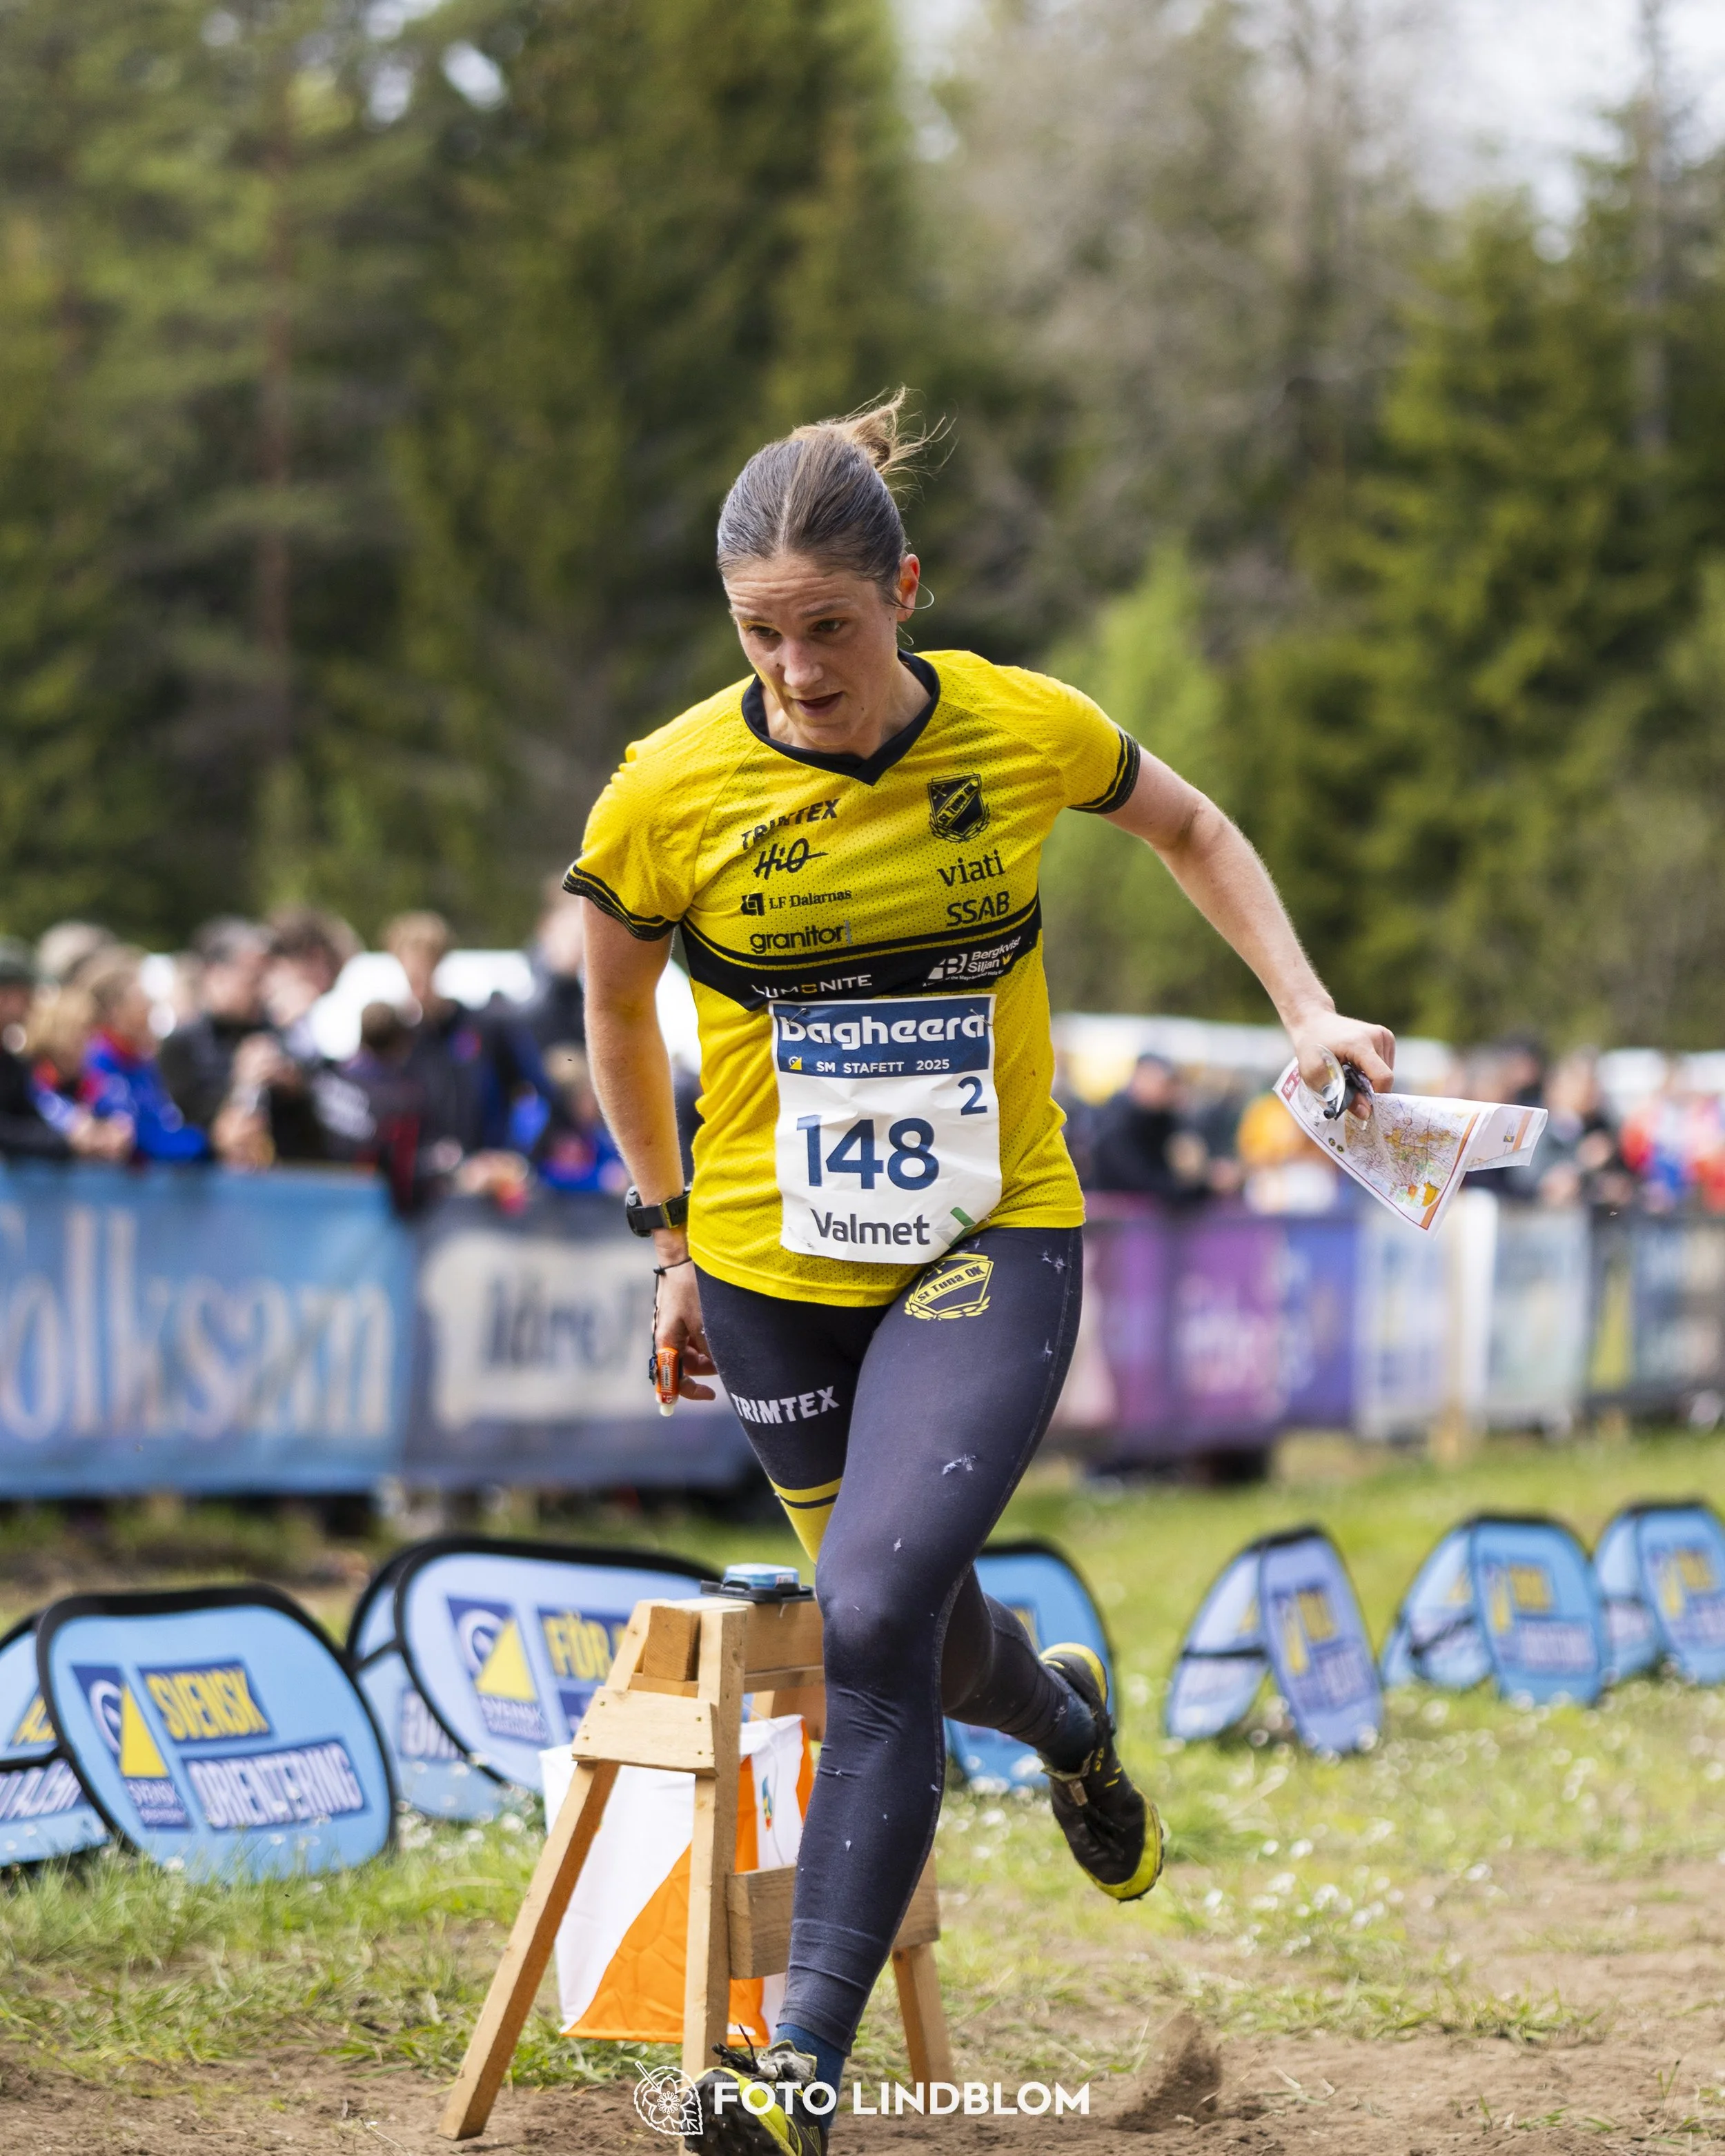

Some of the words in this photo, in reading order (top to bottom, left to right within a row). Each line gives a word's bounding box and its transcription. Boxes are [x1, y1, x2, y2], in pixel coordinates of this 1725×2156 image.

[936, 849, 1005, 887] viati
[769, 896, 787, 910] LF
[789, 889, 852, 909] Dalarnas
[946, 891, 1010, 927] SSAB
[749, 924, 844, 954] granitor
[972, 936, 1021, 961] Bergkvist
[967, 959, 1000, 973] Siljan
[816, 1060, 836, 1073] SM
[843, 1061, 905, 1074] STAFETT
[916, 1058, 950, 1071] 2025
[958, 1076, 988, 1116] 2
[796, 1114, 940, 1191] 148
[810, 1207, 931, 1245] Valmet
[931, 1274, 965, 1292] Tuna
[965, 1265, 986, 1278] OK
[730, 1385, 840, 1424] TRIMTEX
[145, 1666, 269, 1741] SVENSK
[186, 1741, 364, 1830] ORIENTERING
